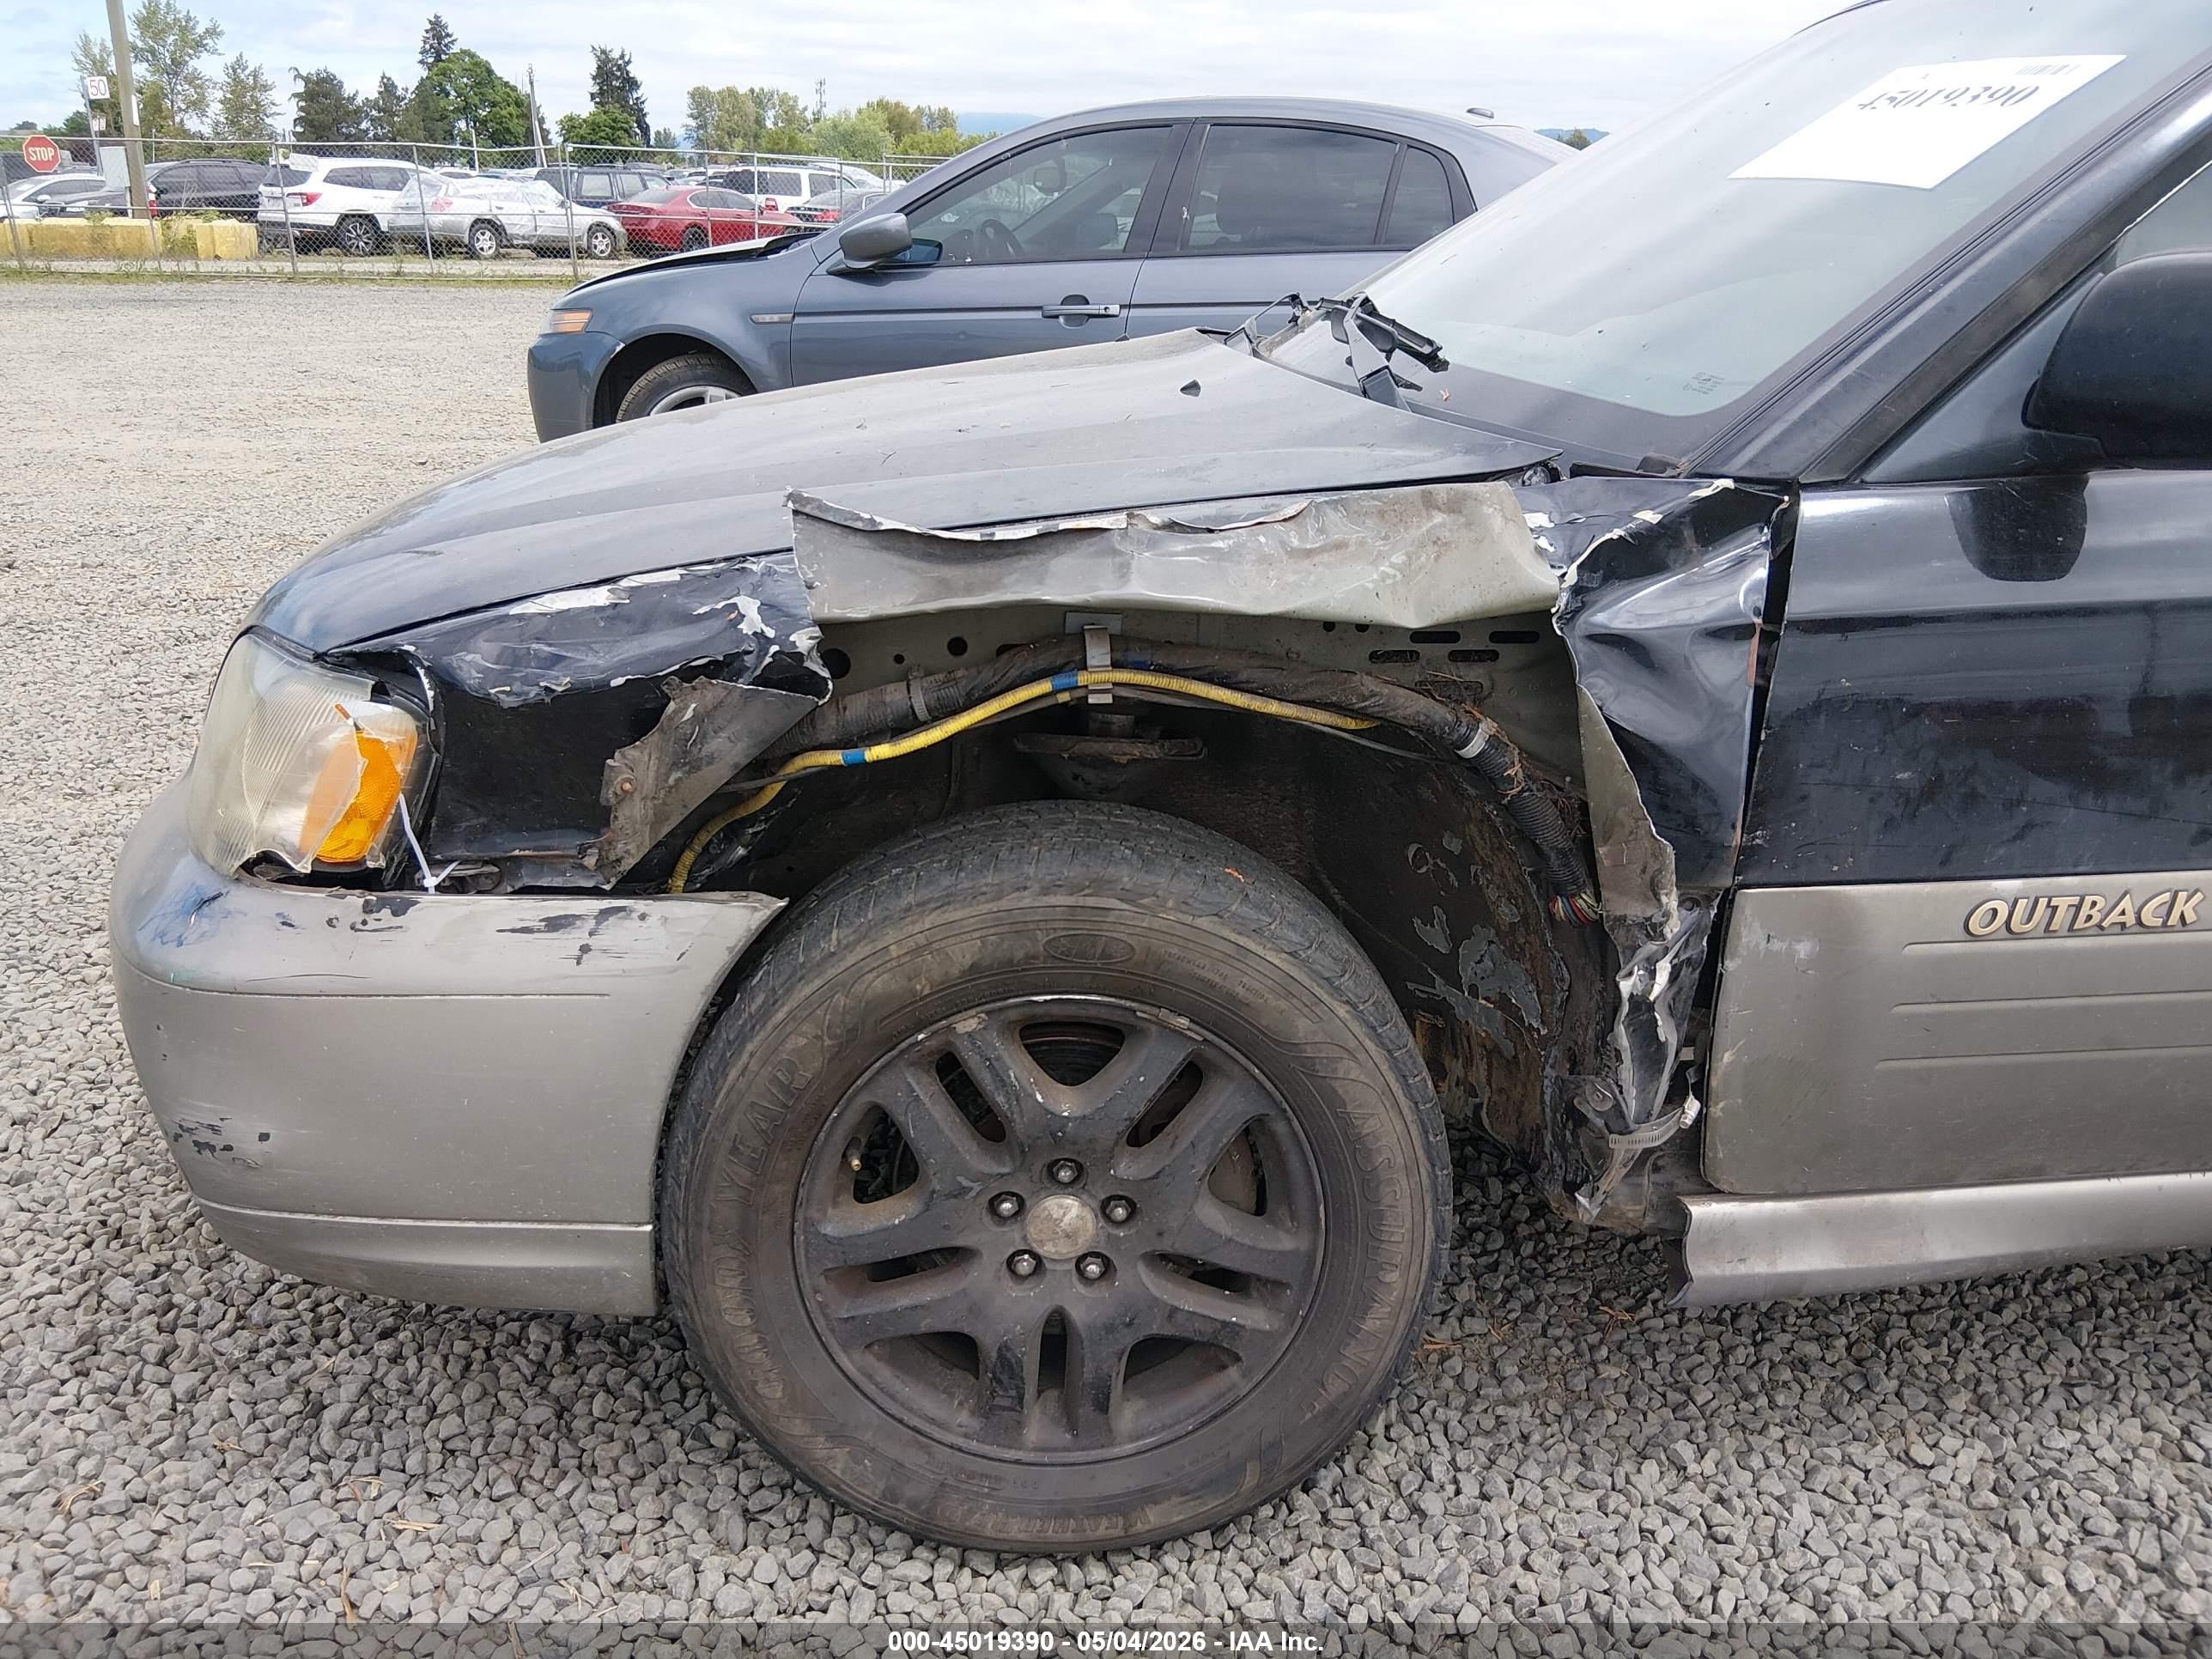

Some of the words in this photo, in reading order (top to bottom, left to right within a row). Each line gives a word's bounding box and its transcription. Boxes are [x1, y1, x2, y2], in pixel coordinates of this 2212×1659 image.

[89, 80, 106, 96] 50
[1857, 85, 2040, 111] 45019390
[28, 148, 55, 161] STOP
[1964, 888, 2204, 937] OUTBACK
